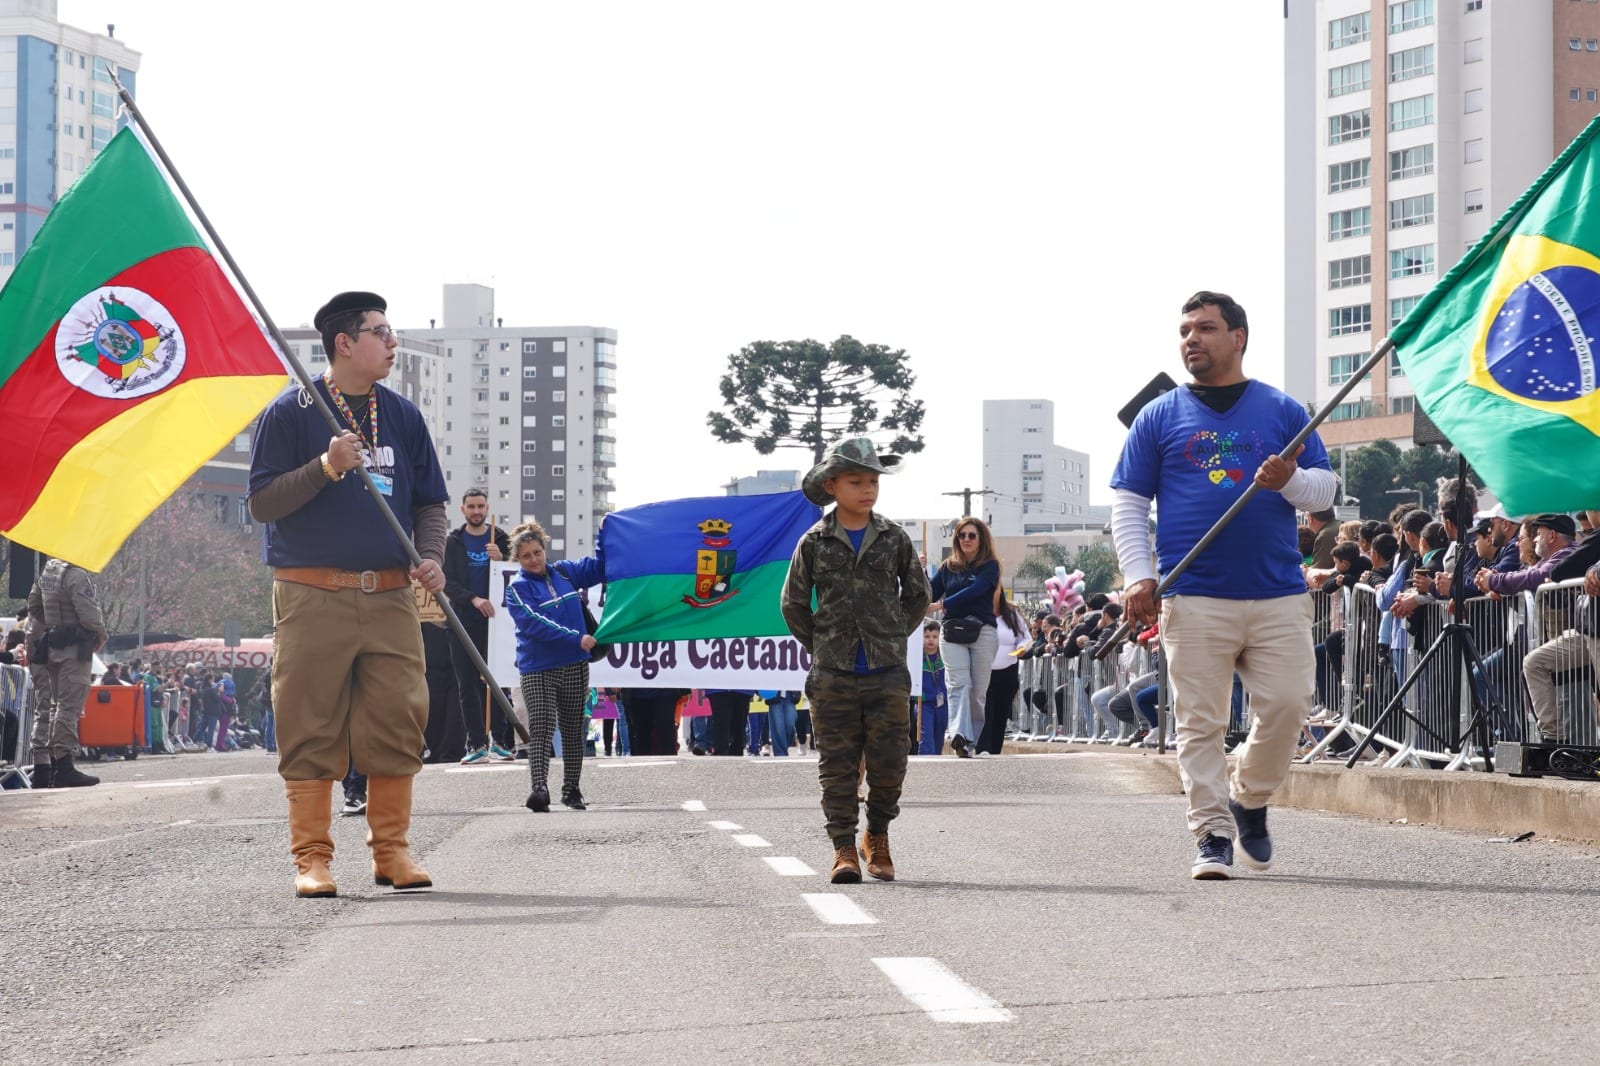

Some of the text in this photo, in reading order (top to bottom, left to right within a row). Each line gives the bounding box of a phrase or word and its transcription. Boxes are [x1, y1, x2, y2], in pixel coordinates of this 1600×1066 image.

[1532, 275, 1566, 307] ORDEM
[1196, 442, 1252, 455] Autismo
[606, 640, 677, 680] Olga
